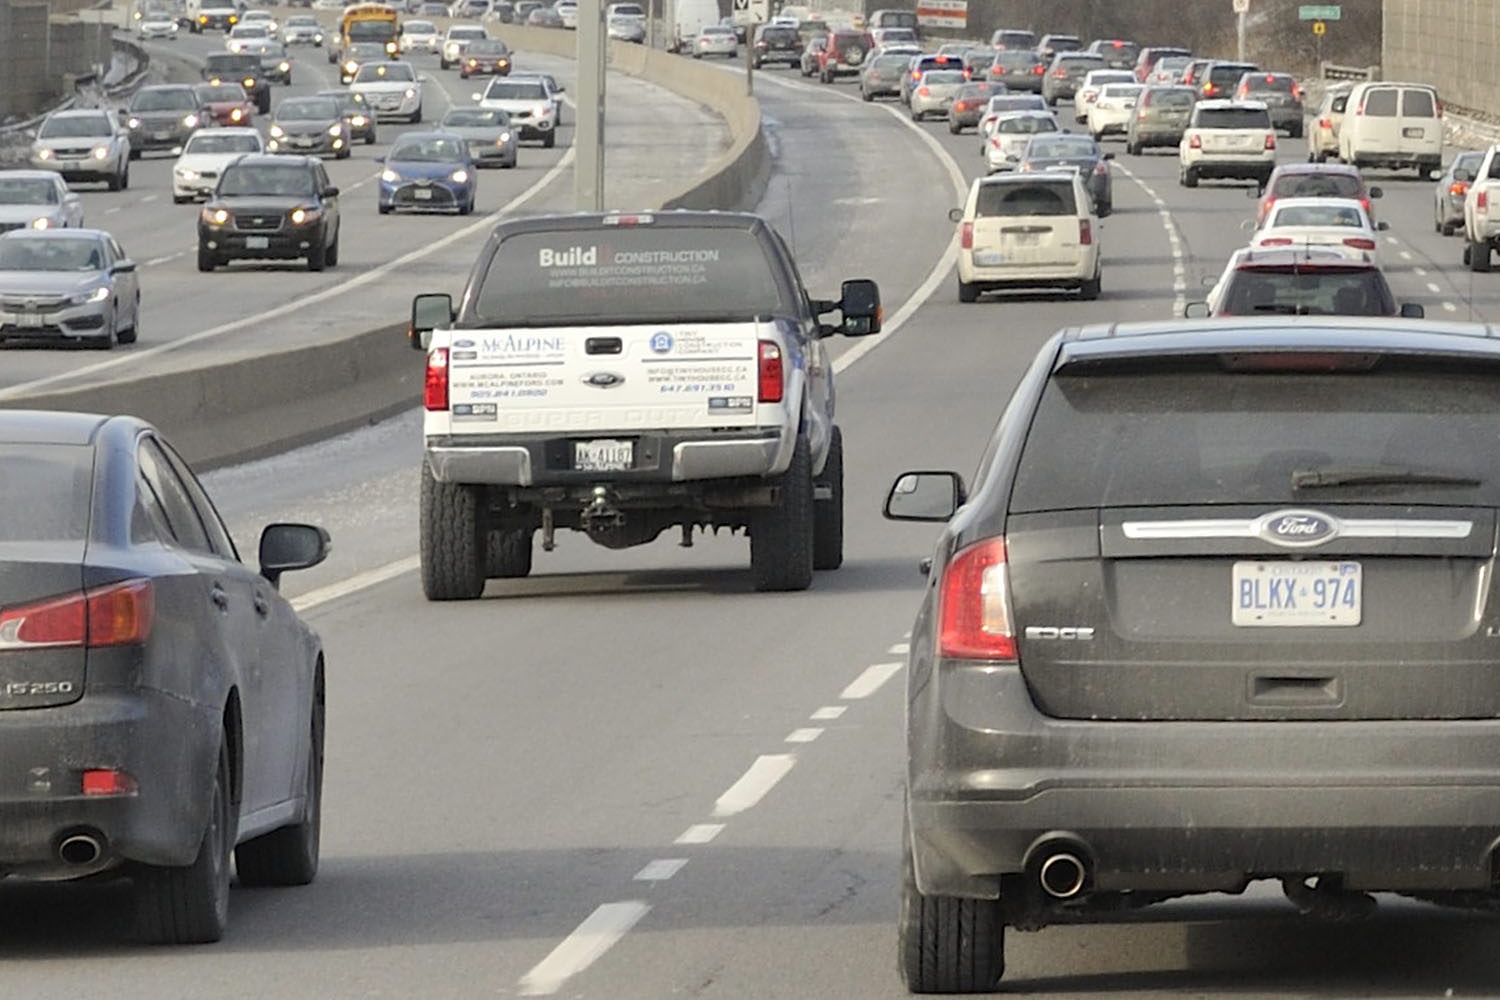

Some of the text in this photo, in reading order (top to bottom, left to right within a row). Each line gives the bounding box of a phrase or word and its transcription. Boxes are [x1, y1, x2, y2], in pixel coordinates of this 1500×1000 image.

[614, 249, 720, 265] CONSTRUCTION
[1278, 516, 1319, 534] Ford
[1240, 578, 1356, 609] BLKX 974
